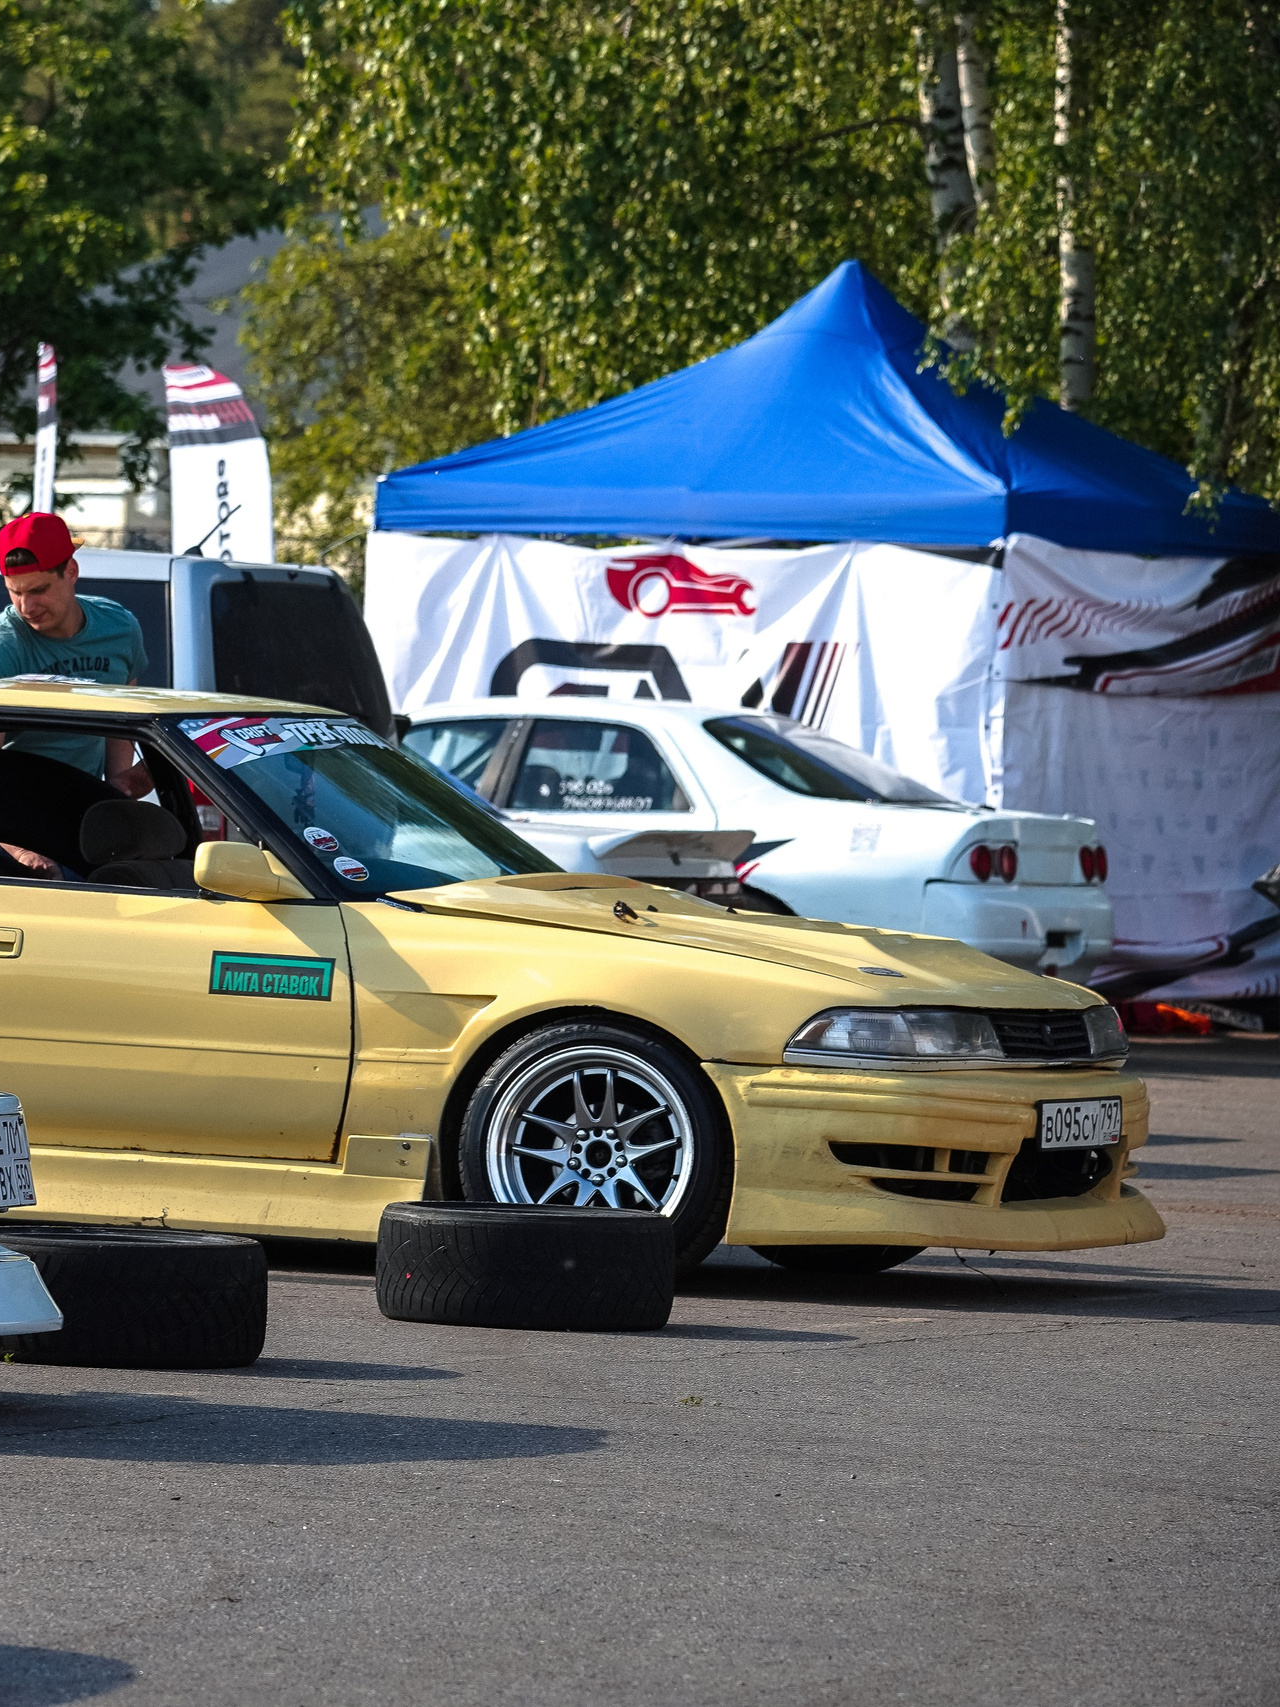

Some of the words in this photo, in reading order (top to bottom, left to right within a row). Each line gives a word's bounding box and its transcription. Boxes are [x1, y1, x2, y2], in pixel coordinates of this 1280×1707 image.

[235, 724, 273, 741] DRIFT
[282, 721, 345, 744] ТРЕК
[222, 970, 259, 993] ЛИГА
[262, 973, 320, 997] СТАВОК
[1101, 1102, 1119, 1130] 797
